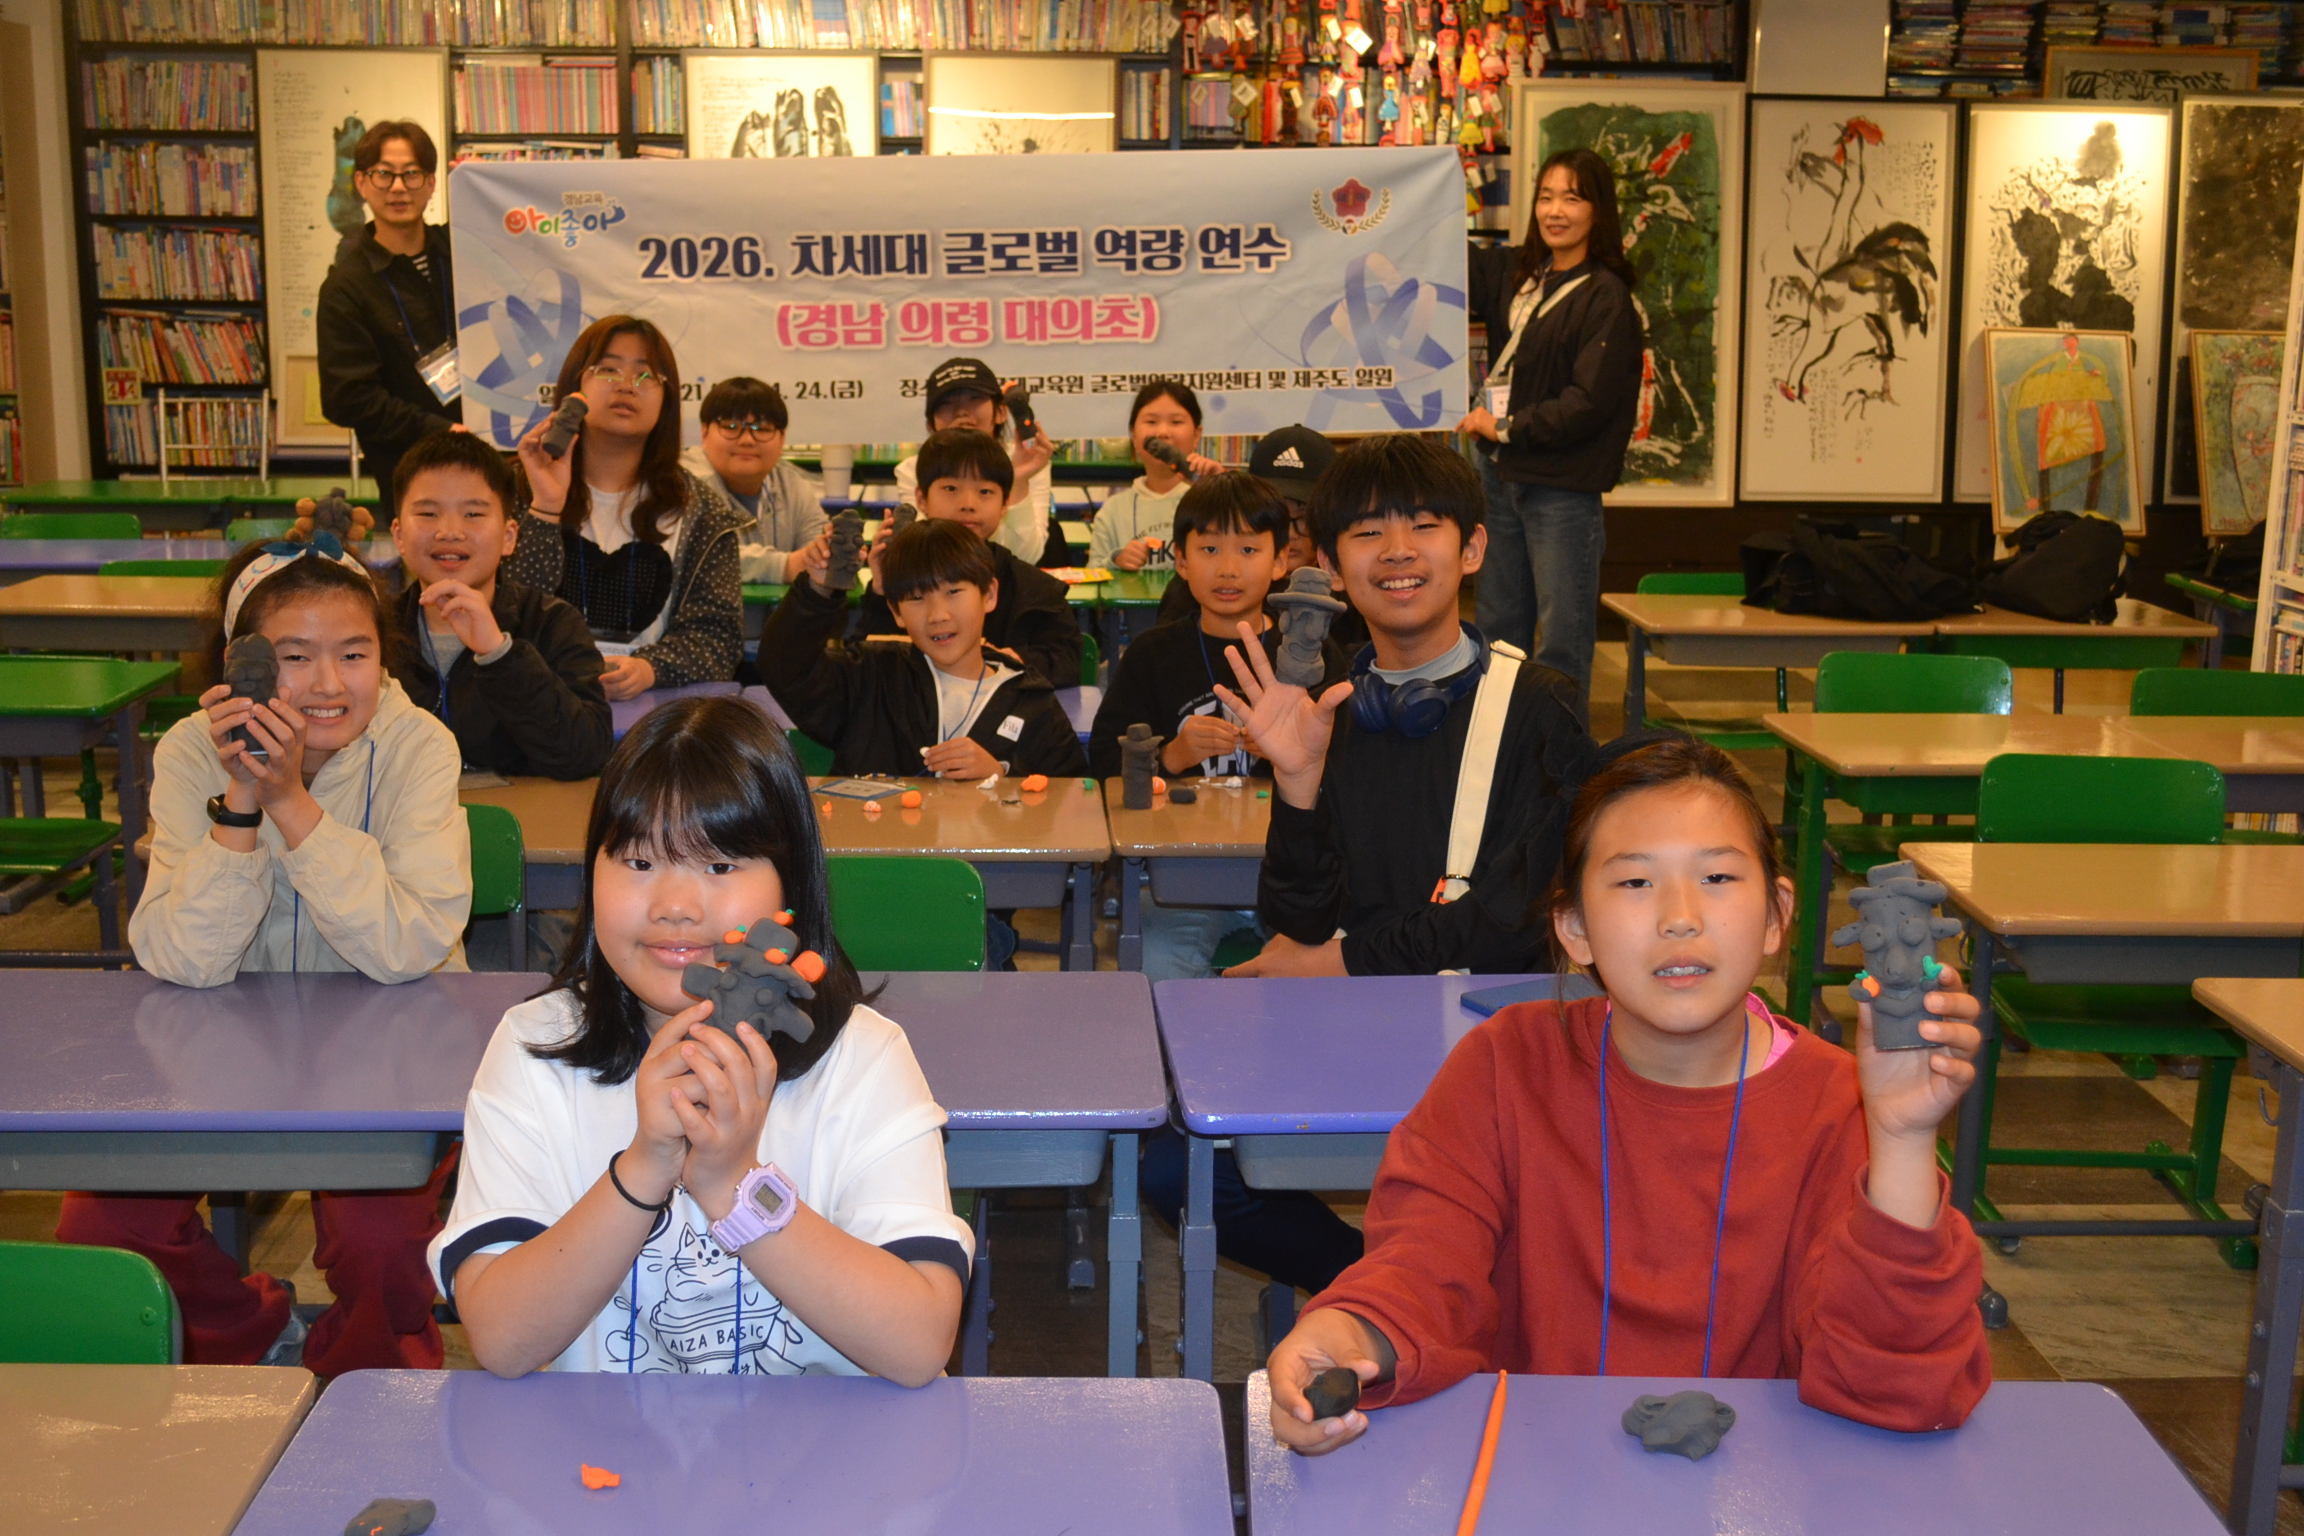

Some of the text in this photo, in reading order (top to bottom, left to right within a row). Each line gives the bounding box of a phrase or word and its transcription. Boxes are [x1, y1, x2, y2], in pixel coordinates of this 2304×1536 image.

[505, 206, 626, 248] 아이좋아
[638, 226, 1287, 279] 2026. 차세대 글로벌 역량 연수
[776, 297, 1156, 348] (경남 의령 대의초)
[1267, 370, 1288, 389] 및
[1292, 369, 1350, 389] 제주도
[1355, 368, 1394, 389] 일원
[1273, 459, 1304, 469] adidas
[1002, 720, 1019, 734] Fila
[670, 1324, 764, 1353] AIZA BASIC
